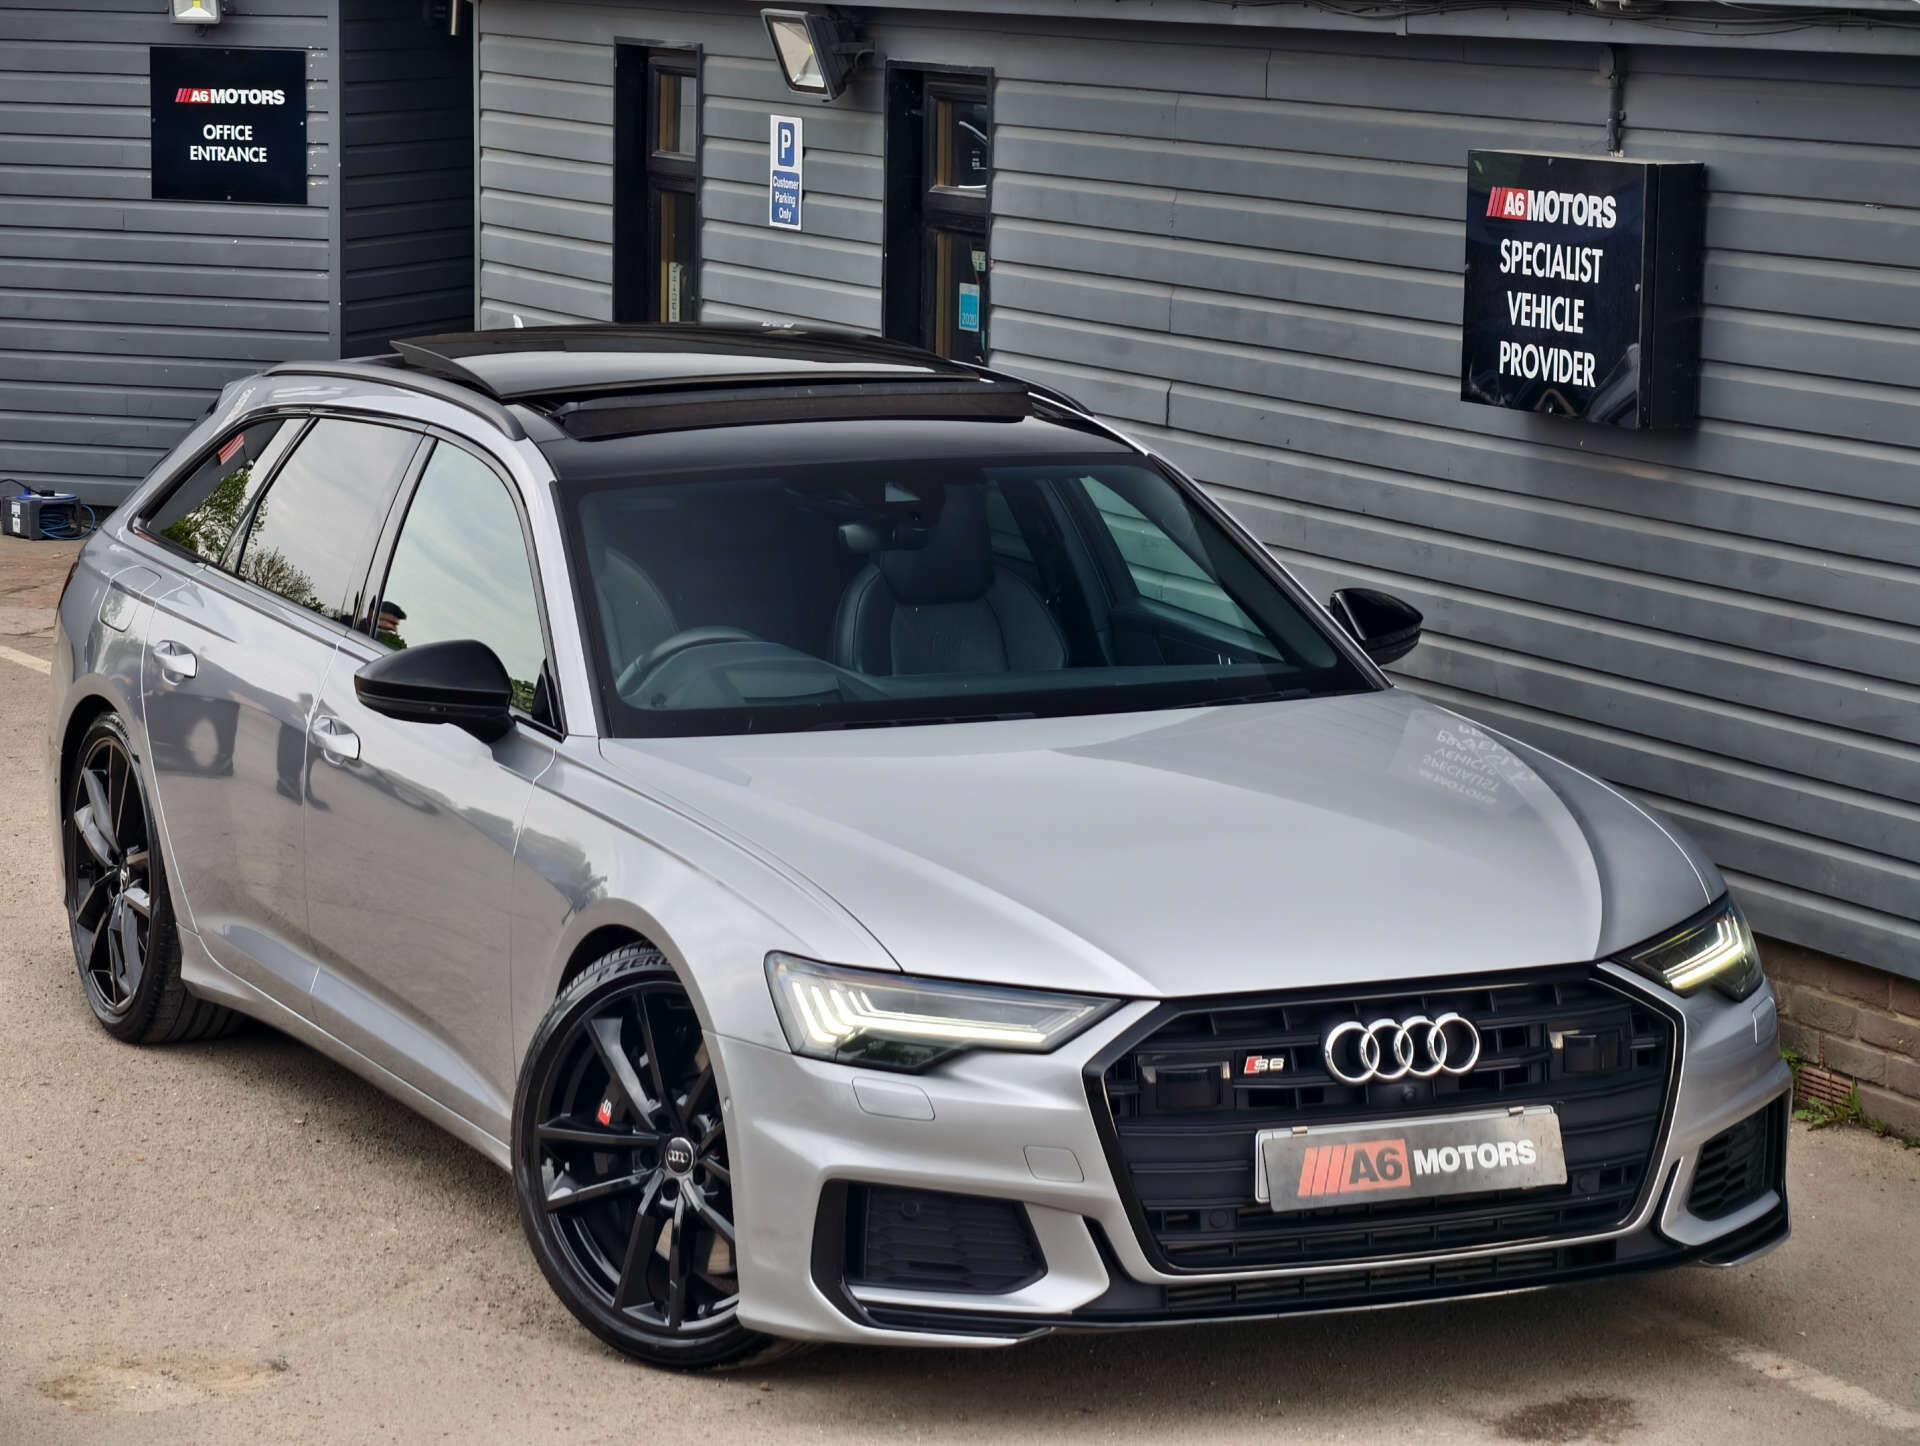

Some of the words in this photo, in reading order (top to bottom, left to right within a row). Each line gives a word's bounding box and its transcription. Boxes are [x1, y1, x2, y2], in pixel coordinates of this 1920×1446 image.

[191, 90, 209, 102] A6
[211, 88, 286, 105] MOTORS
[203, 124, 253, 141] OFFICE
[781, 128, 792, 159] P
[190, 145, 267, 163] ENTRANCE
[773, 175, 799, 190] Customer
[775, 191, 796, 207] Parking
[1504, 191, 1525, 217] A6
[1527, 190, 1617, 229] MOTORS
[779, 207, 792, 222] Only
[1500, 238, 1604, 284] SPECIALIST
[1507, 291, 1585, 334] VEHICLE
[1499, 340, 1596, 388] PROVIDER
[1350, 1147, 1403, 1185] A6
[1412, 1139, 1537, 1176] MOTORS
